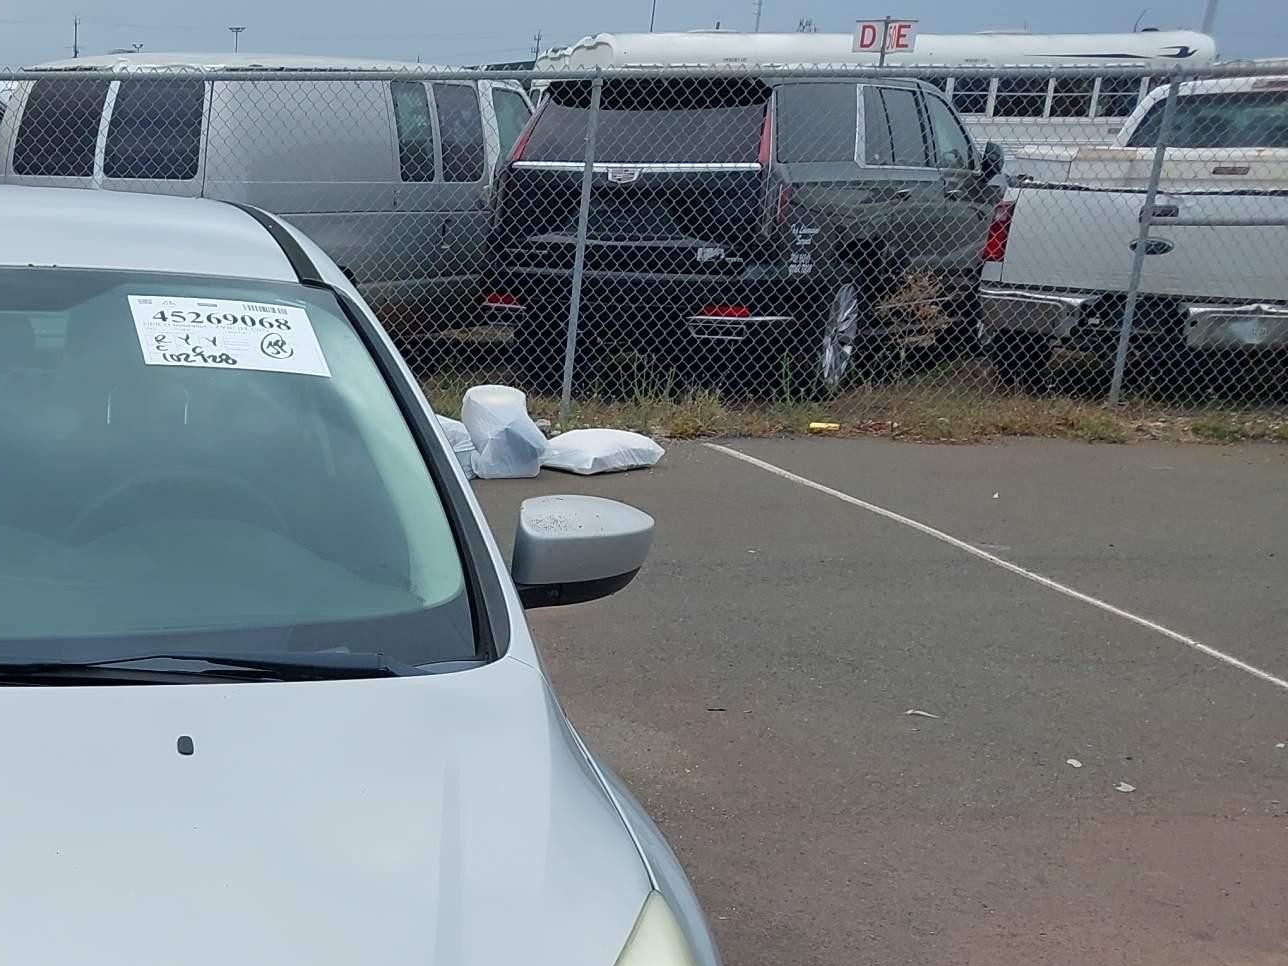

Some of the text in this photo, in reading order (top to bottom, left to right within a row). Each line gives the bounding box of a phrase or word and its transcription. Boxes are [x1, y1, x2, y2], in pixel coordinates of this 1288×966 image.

[860, 25, 876, 48] D
[895, 24, 912, 48] E
[152, 309, 292, 332] 45269068
